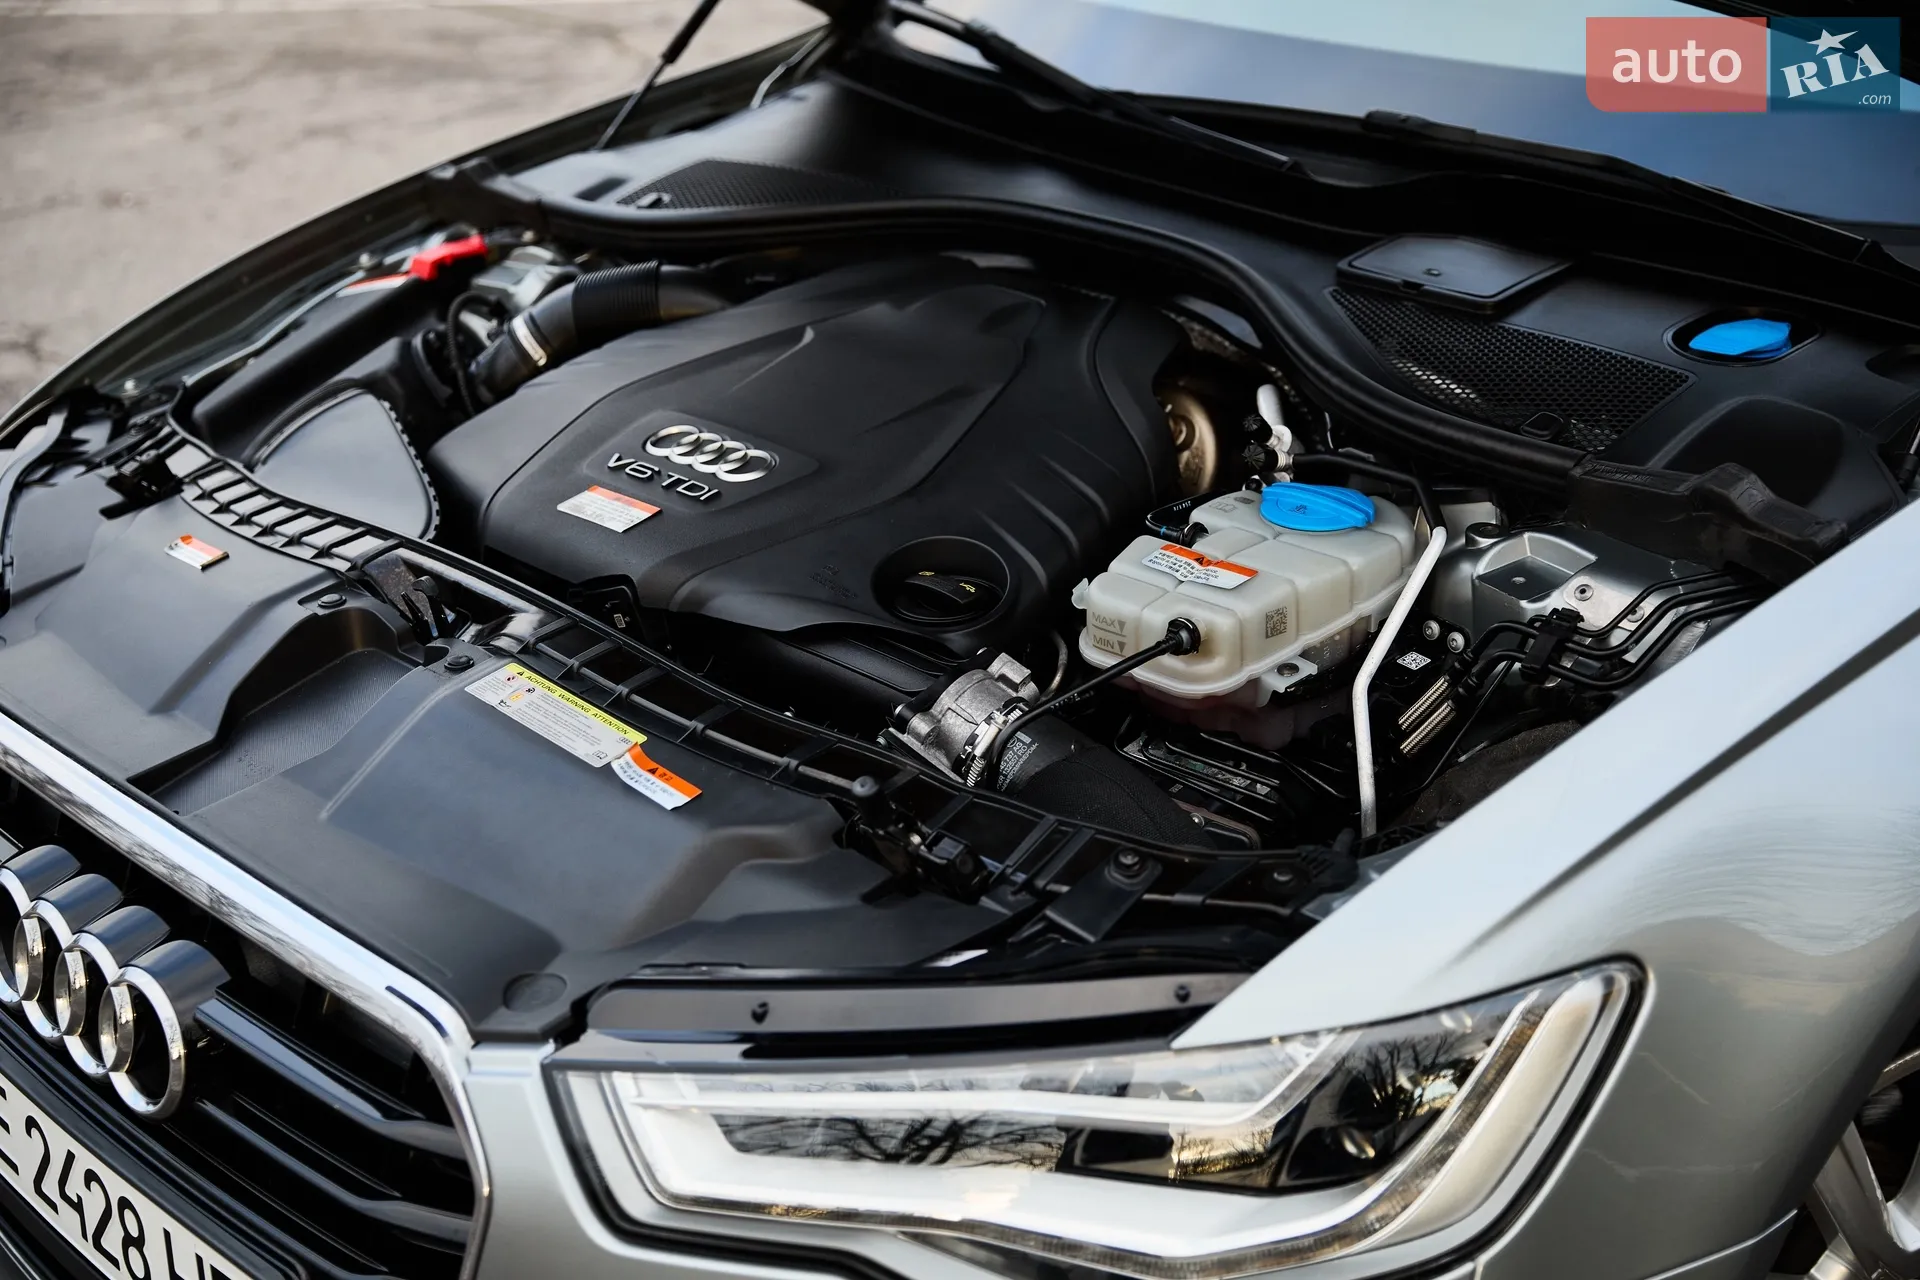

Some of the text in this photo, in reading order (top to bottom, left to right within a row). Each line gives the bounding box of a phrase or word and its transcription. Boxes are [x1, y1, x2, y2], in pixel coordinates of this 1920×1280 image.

[607, 452, 721, 501] V6 TDI
[1092, 612, 1117, 629] MAX
[1092, 634, 1115, 650] MIN
[524, 675, 630, 735] ACHTUNG WARNING ATTENTION
[25, 1115, 152, 1280] 2428
